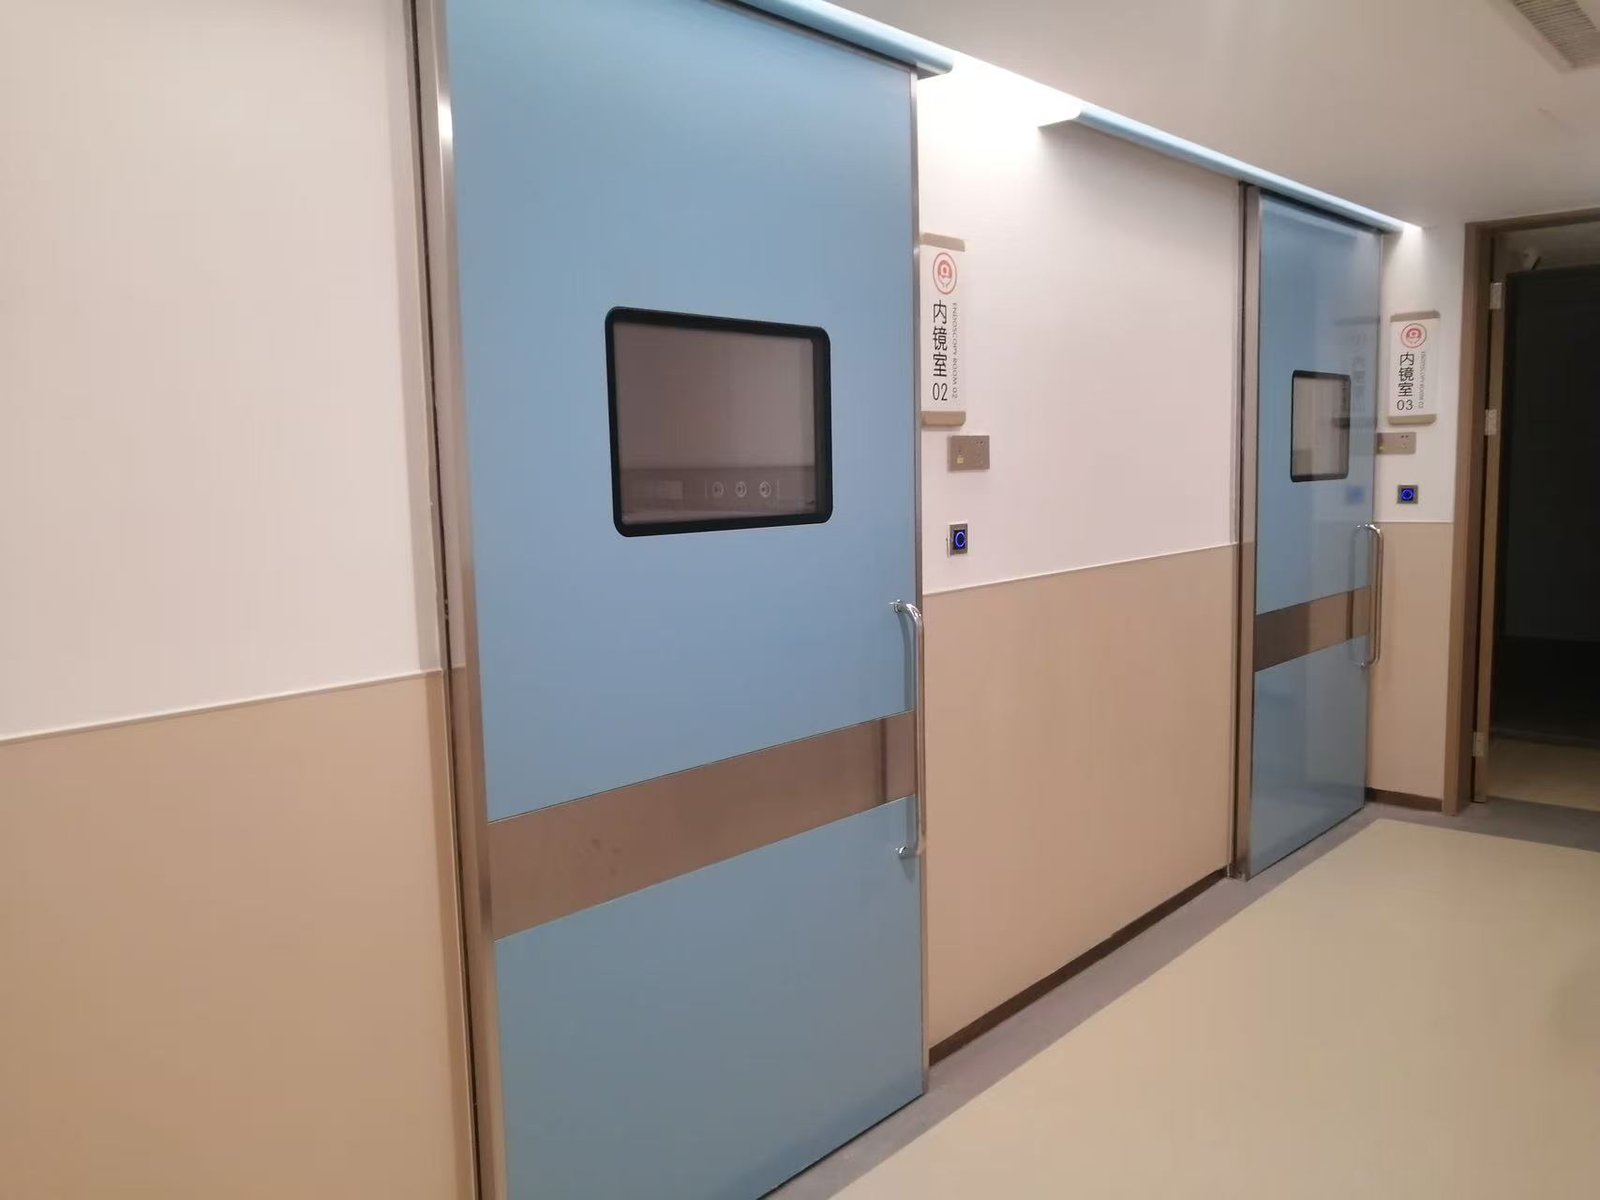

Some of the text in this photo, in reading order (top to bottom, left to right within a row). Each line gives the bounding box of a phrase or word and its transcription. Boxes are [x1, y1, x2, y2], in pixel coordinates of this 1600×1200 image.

[932, 299, 948, 377] 内镜室
[1398, 352, 1415, 397] 内镜室
[932, 382, 948, 401] 02
[1396, 399, 1413, 411] 03
